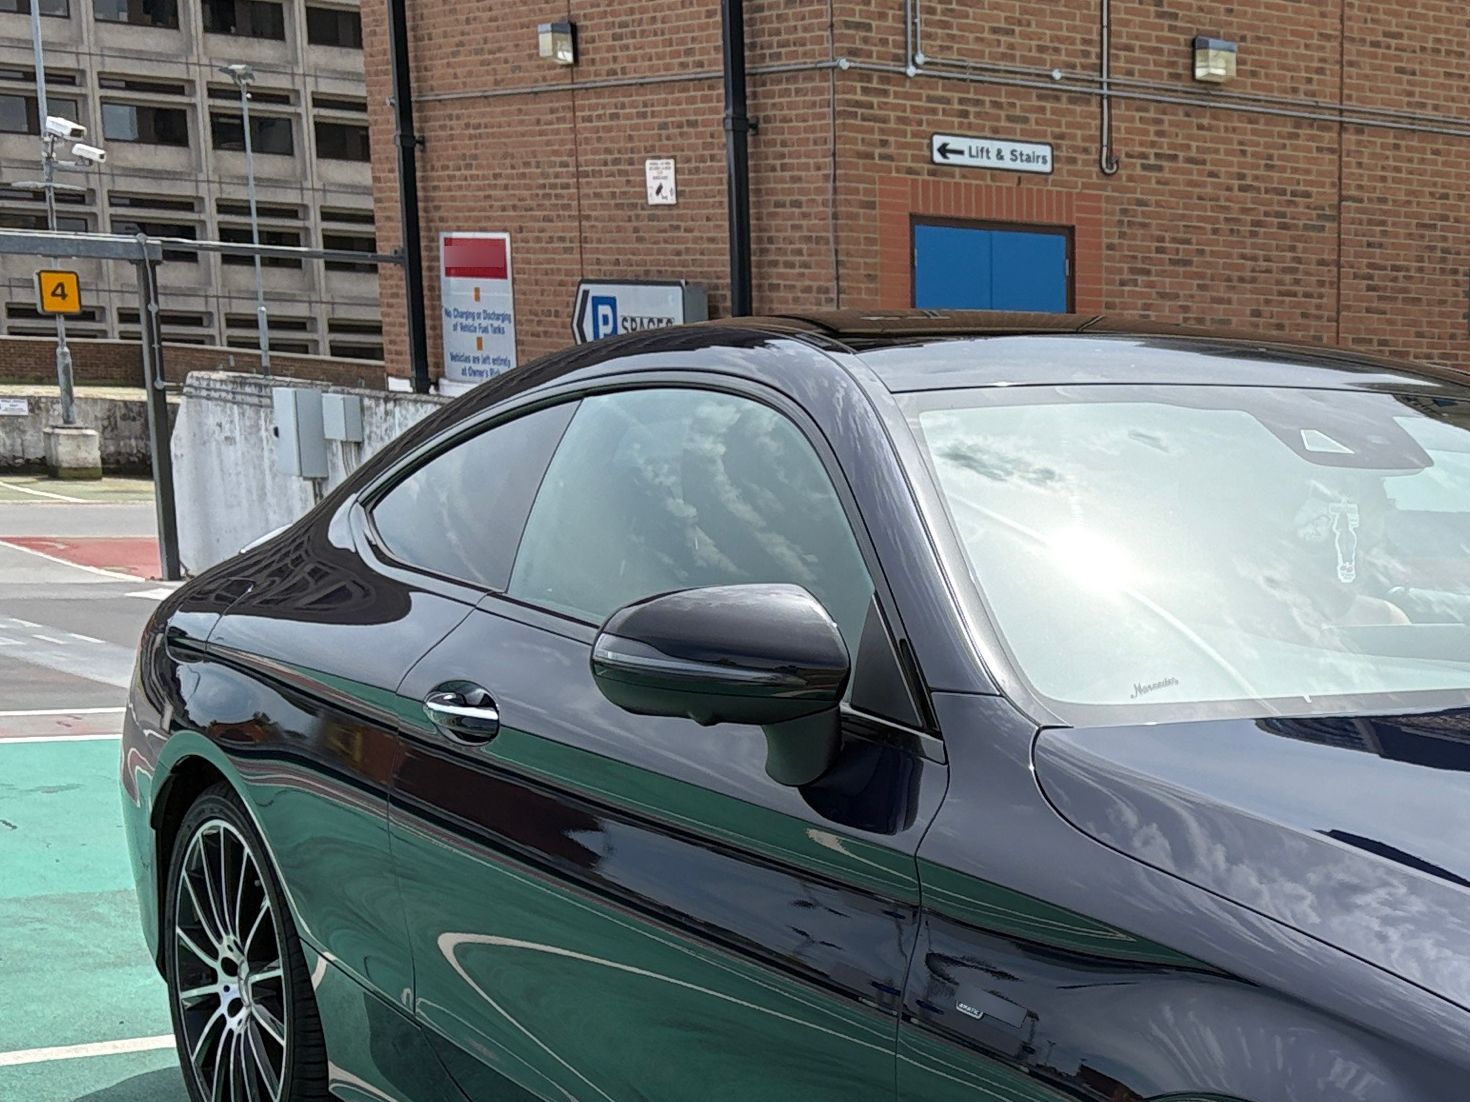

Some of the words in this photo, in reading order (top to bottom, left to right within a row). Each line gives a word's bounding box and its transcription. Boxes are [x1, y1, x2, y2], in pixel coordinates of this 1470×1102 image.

[968, 145, 991, 160] Lift
[995, 148, 1005, 161] &
[1010, 149, 1048, 165] Stairs
[51, 282, 68, 301] 4
